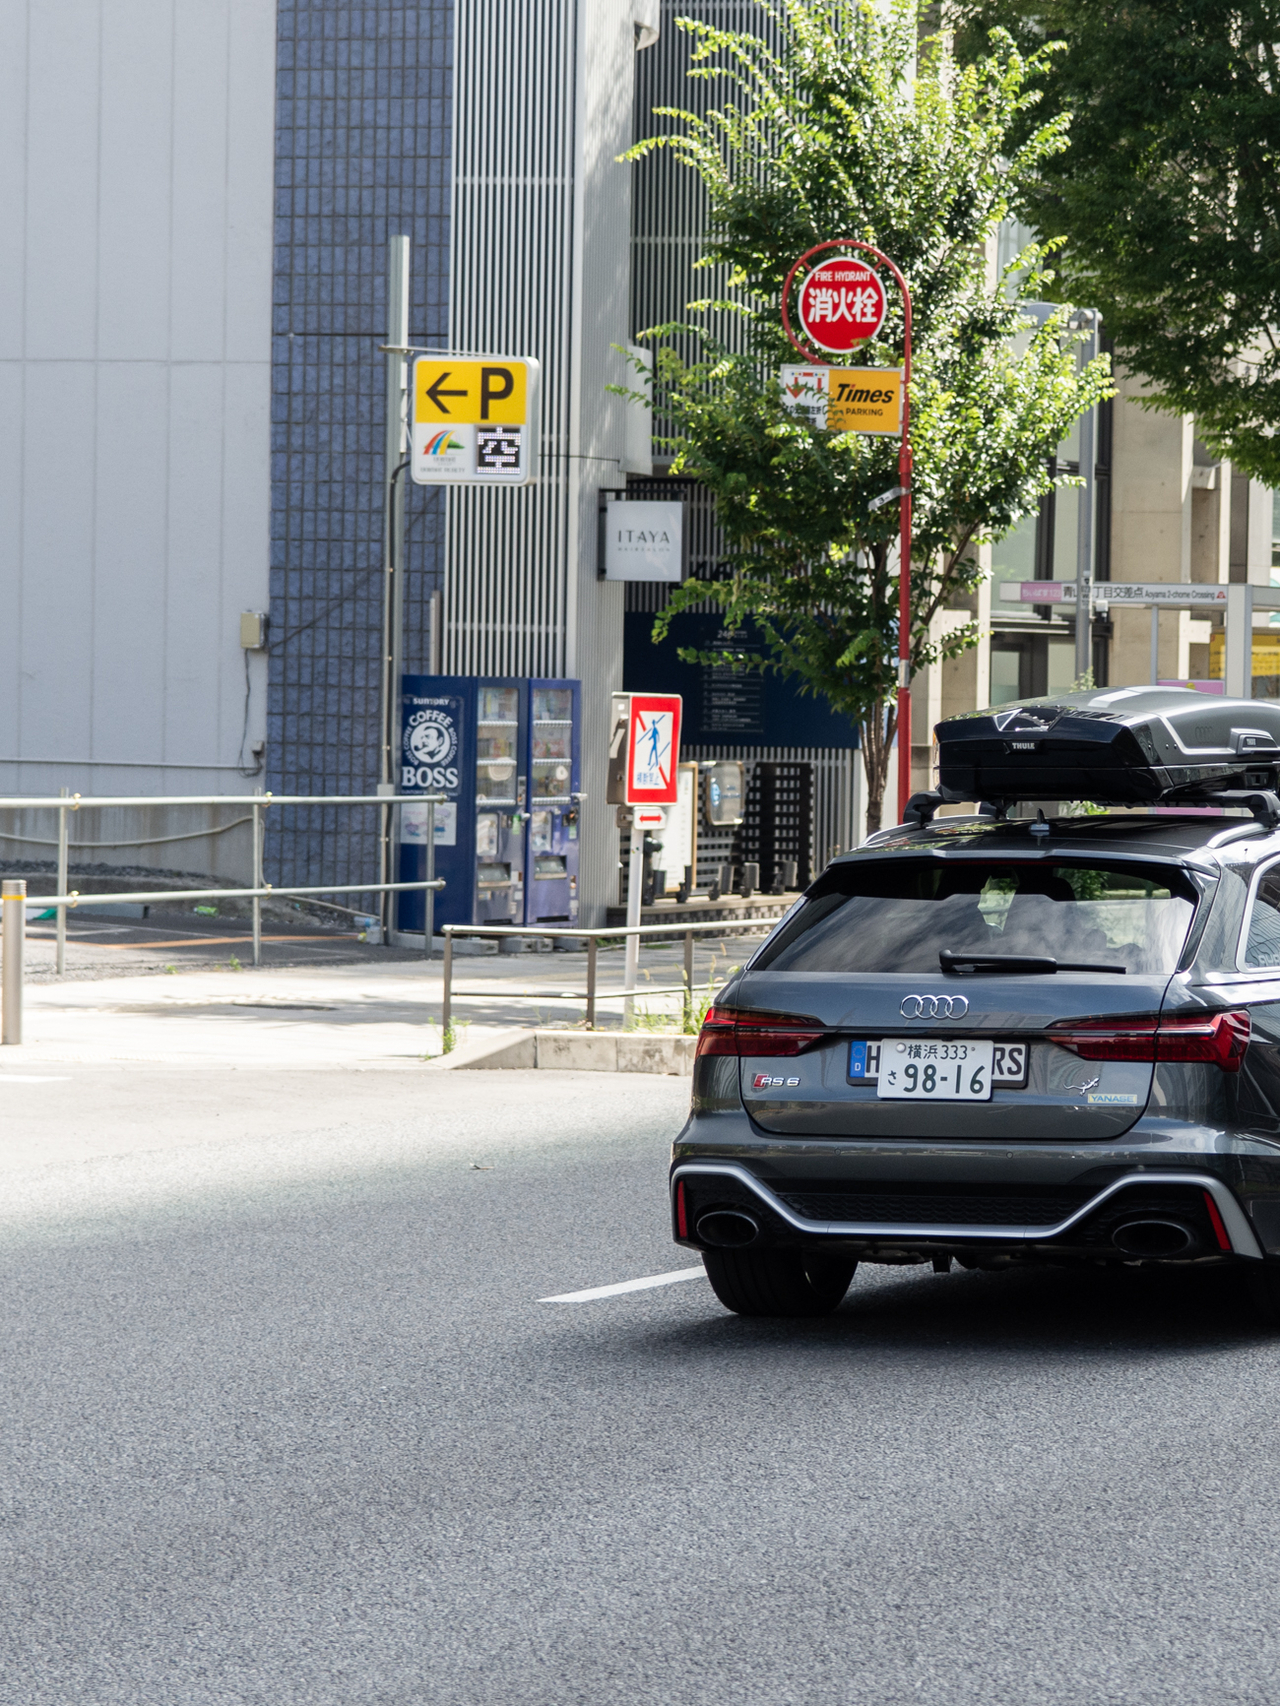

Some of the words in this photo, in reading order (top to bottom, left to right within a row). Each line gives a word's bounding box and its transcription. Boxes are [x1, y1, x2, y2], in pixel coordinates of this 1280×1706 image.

[815, 271, 833, 282] FIRE
[835, 271, 871, 282] HYDRANT
[808, 287, 878, 323] 消火栓
[480, 367, 514, 420] P
[836, 383, 894, 404] Times
[845, 407, 883, 417] PARKING
[477, 426, 521, 474] 空
[618, 530, 670, 543] ITAYA
[1063, 586, 1144, 599] 青丁目交差点
[1145, 590, 1166, 600] Aoyama
[1167, 591, 1190, 599] 2-chome
[1191, 590, 1215, 601] Crossing
[409, 710, 453, 727] COFFEE
[1011, 742, 1036, 750] THULE
[402, 766, 459, 788] BOSS
[854, 1063, 861, 1071] D
[887, 1070, 897, 1086] さ
[903, 1063, 985, 1094] 98-16
[1091, 1095, 1134, 1103] YANASE
